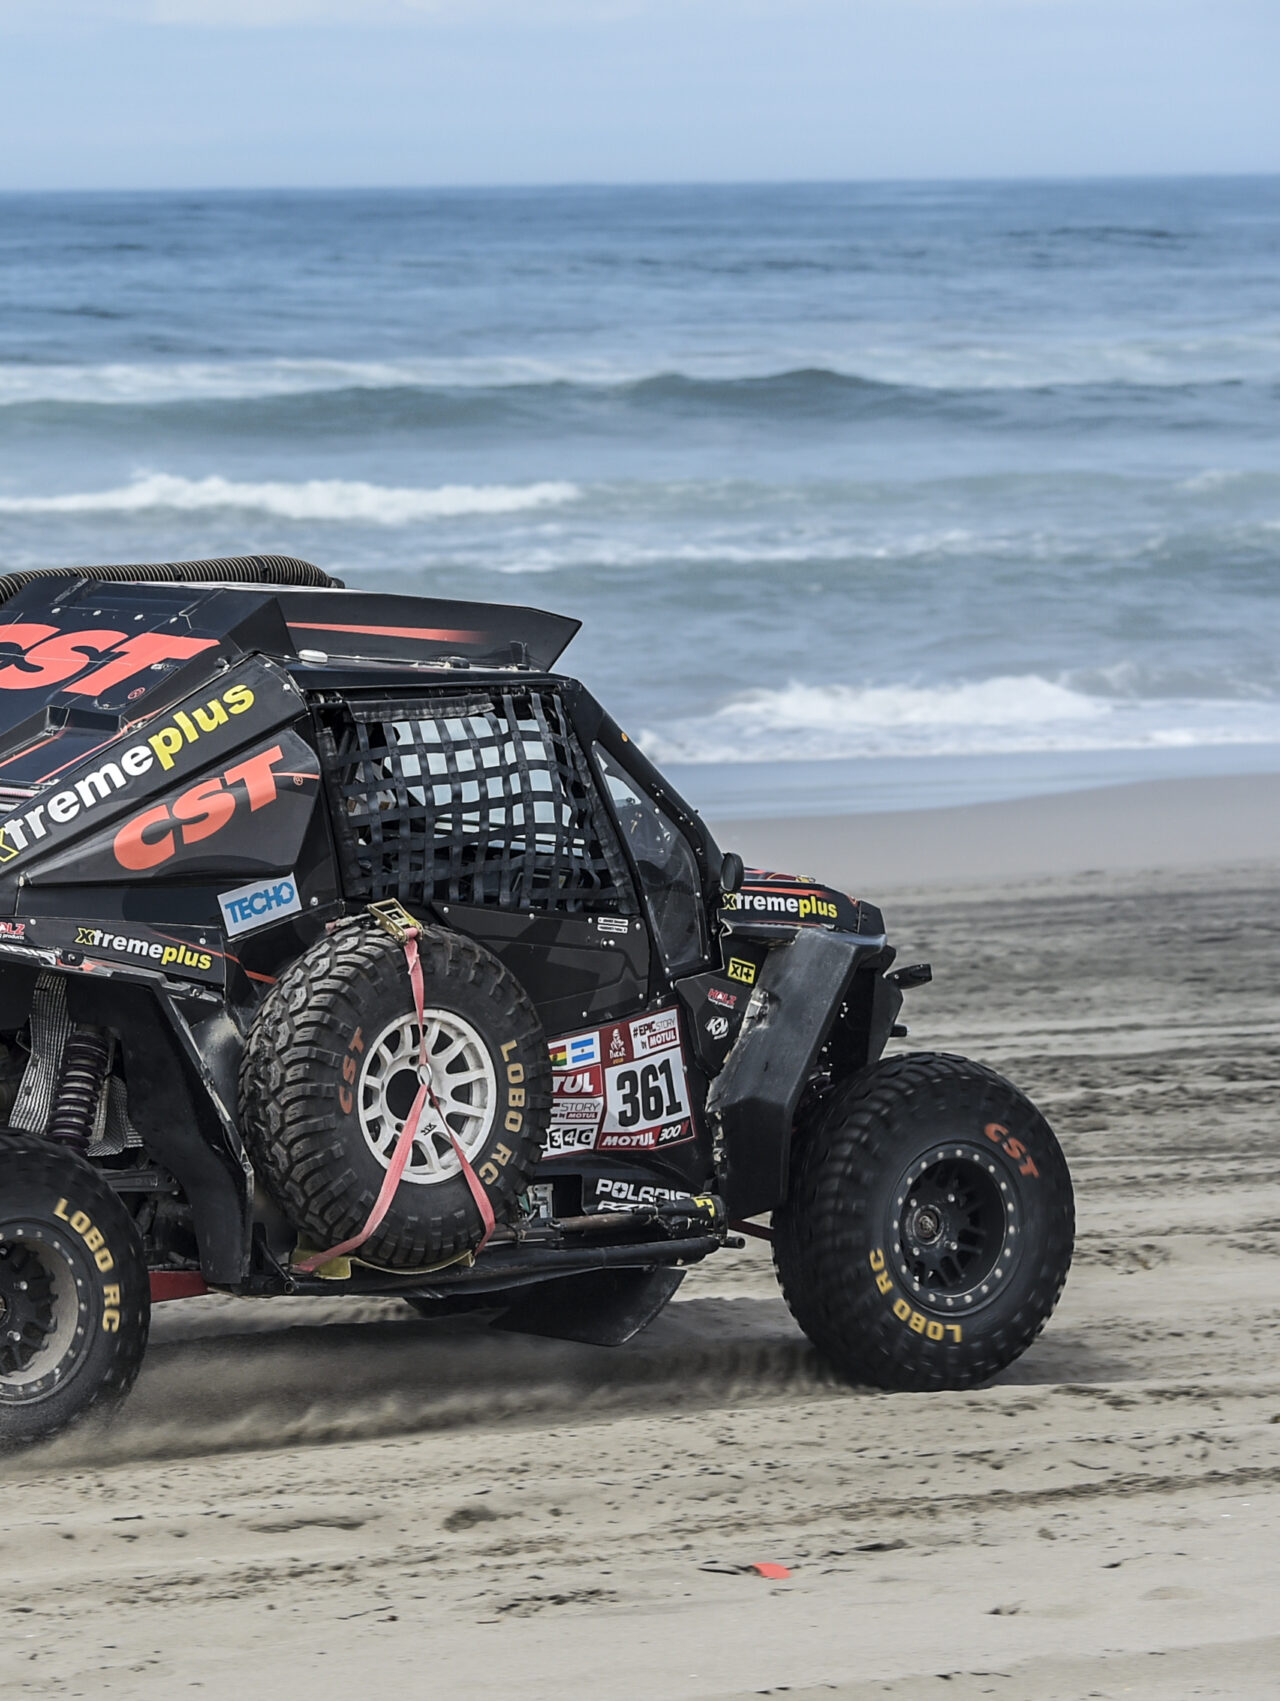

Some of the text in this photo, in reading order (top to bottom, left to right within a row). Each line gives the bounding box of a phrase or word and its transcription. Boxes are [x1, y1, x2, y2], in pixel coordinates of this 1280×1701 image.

[114, 745, 285, 871] CST
[225, 881, 294, 924] TECHO
[649, 1030, 676, 1046] MOTUL
[339, 1027, 365, 1115] CST
[552, 1072, 594, 1093] TUL
[616, 1058, 682, 1127] 361
[480, 1040, 526, 1185] LOBO RC
[553, 1102, 600, 1113] STORY
[601, 1120, 690, 1147] MOTUL 300V
[984, 1122, 1040, 1179] CST
[53, 1198, 120, 1333] LOBO RC
[869, 1248, 963, 1343] LOBO RC
